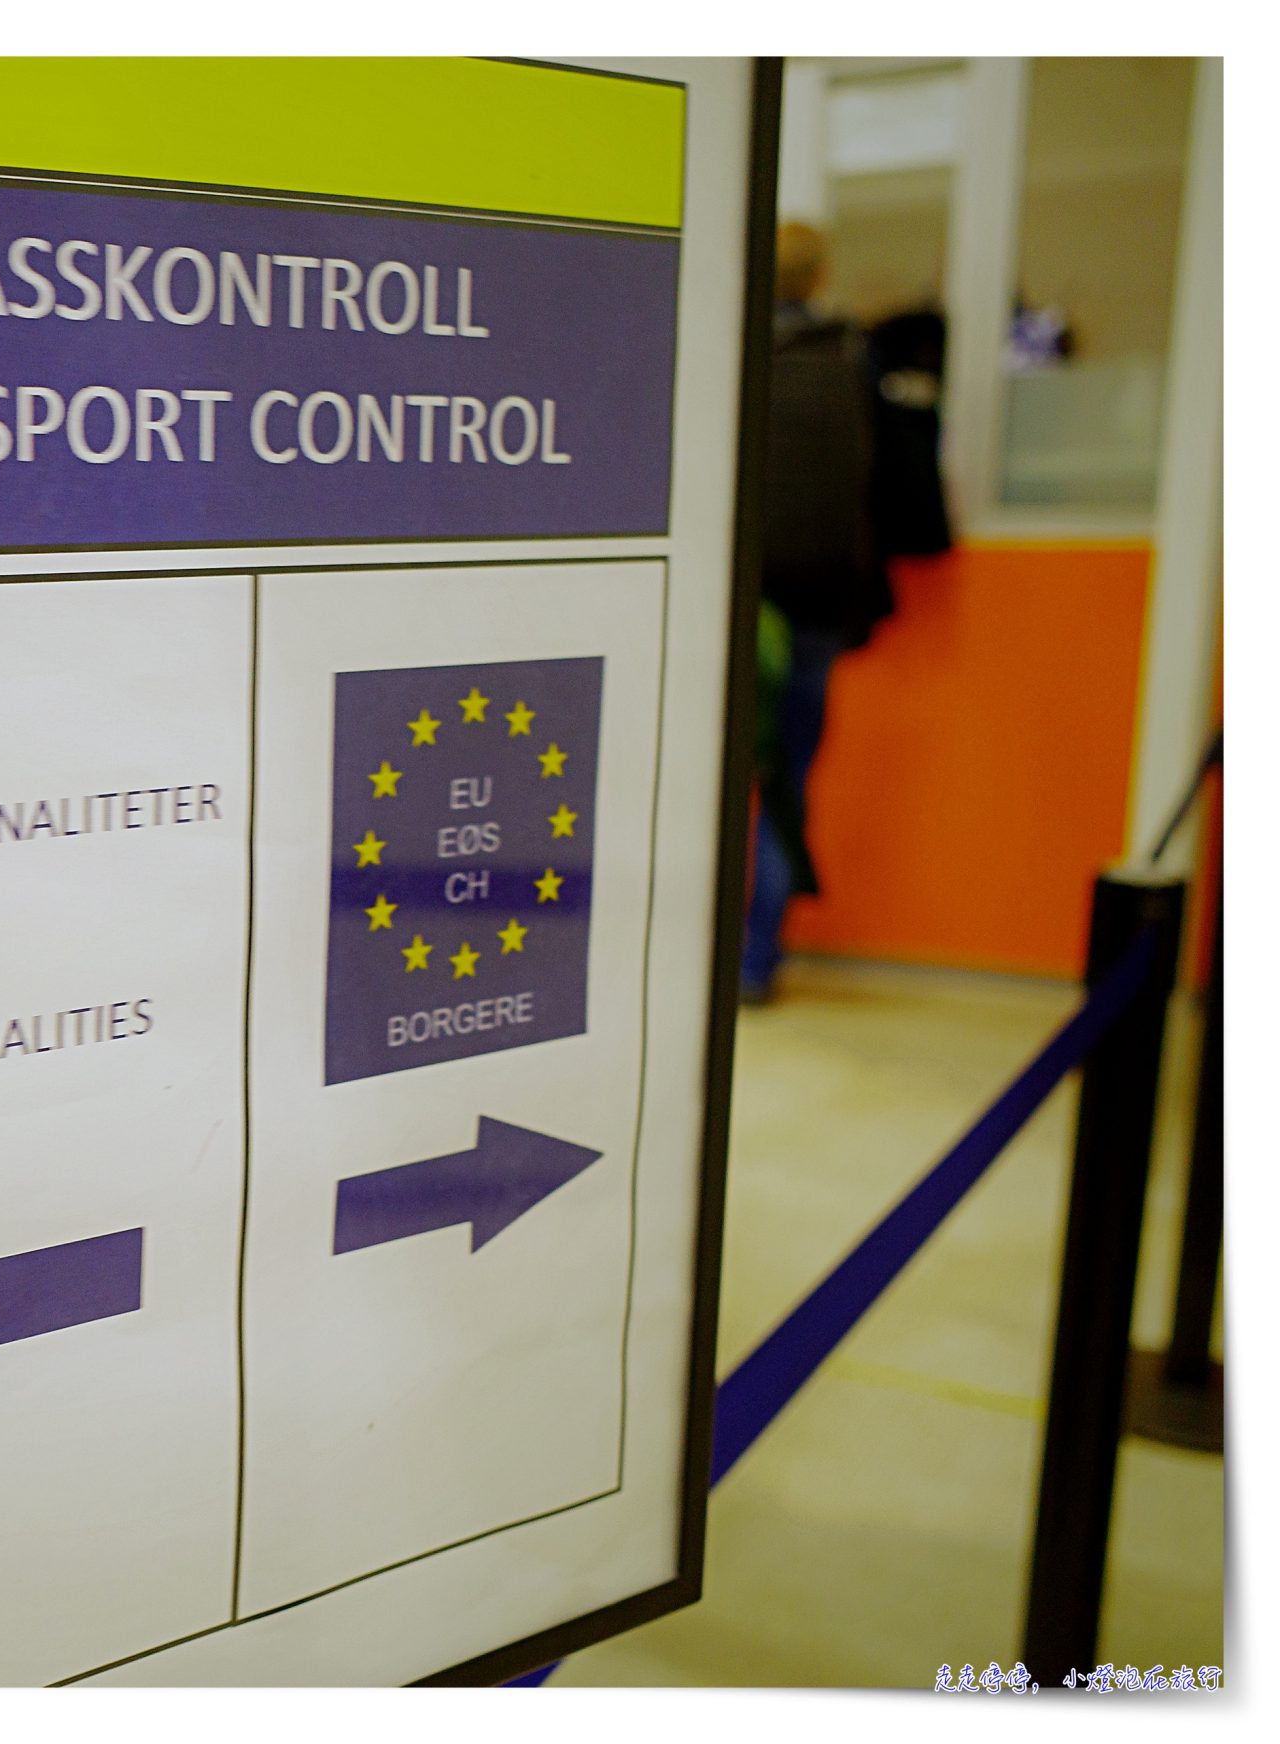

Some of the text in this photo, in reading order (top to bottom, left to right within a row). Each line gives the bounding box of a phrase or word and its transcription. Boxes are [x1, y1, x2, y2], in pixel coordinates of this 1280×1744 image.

[250, 391, 571, 467] CONTROL
[449, 776, 493, 811] EU
[437, 822, 502, 859] EØS
[444, 870, 490, 905] CH
[387, 991, 535, 1048] BORGERE
